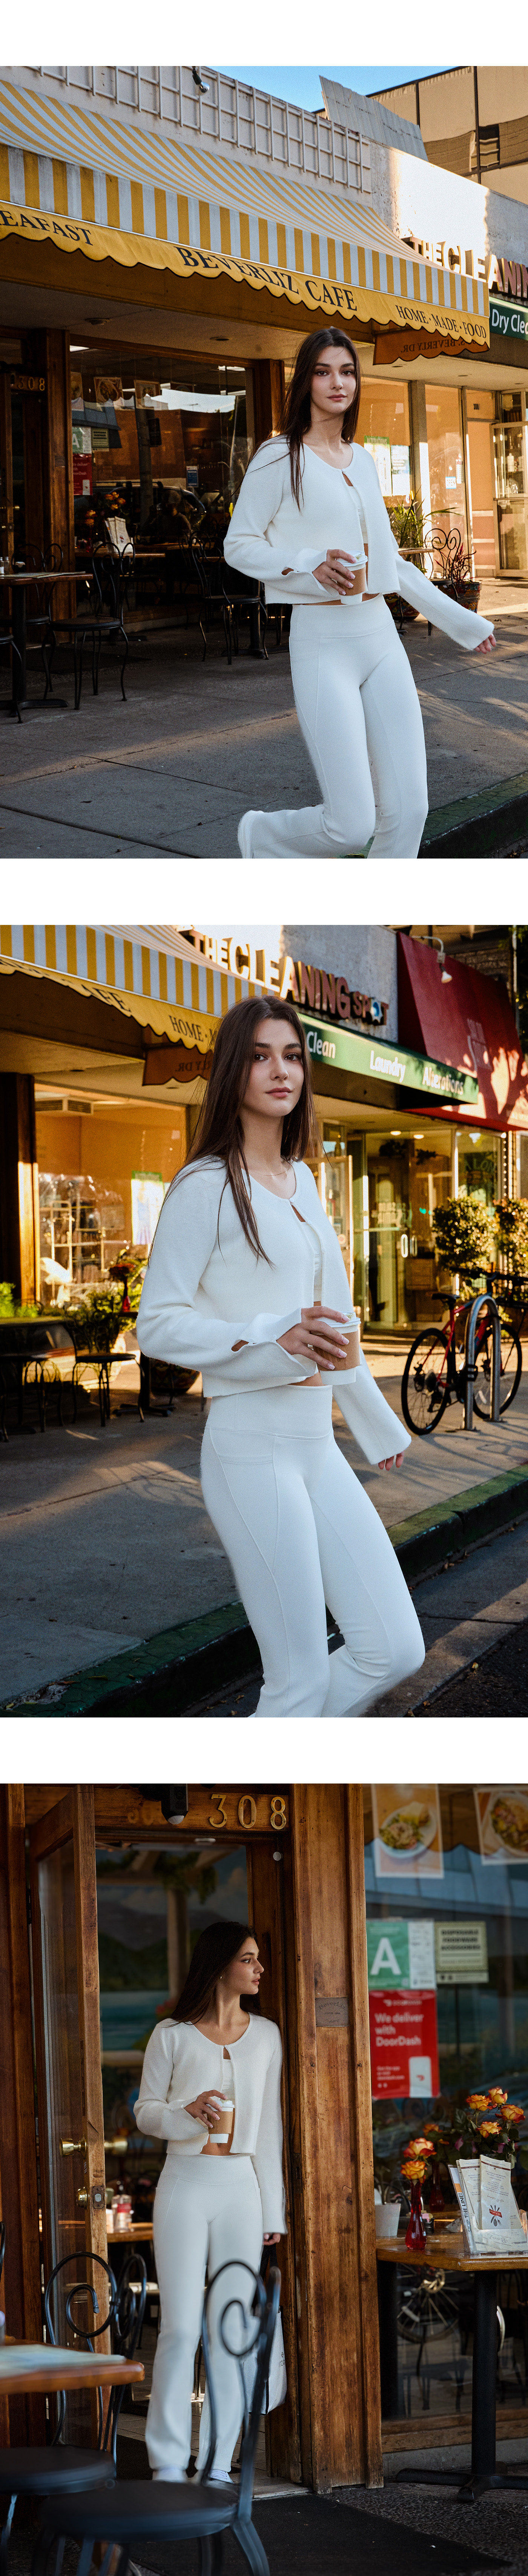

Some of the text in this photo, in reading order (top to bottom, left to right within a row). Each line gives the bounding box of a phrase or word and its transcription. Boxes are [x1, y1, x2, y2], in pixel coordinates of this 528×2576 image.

[0, 210, 93, 246] EAFAST
[409, 236, 442, 266] THE
[173, 246, 357, 311] BEVERLIZ CAFE
[395, 305, 487, 339] HOME MADE FOOD
[491, 309, 510, 334] Dry
[18, 377, 45, 391] 308
[72, 433, 80, 448] A
[189, 929, 389, 1025] THE CLEANING SPOT
[169, 1015, 204, 1042] HOME
[307, 1031, 464, 1095] Clean Laundry Alterations
[209, 1793, 287, 1830] 308
[370, 1937, 402, 1975] A
[374, 2011, 425, 2024] We deliver
[375, 2024, 396, 2035] with
[375, 2035, 422, 2047] DoorDash
